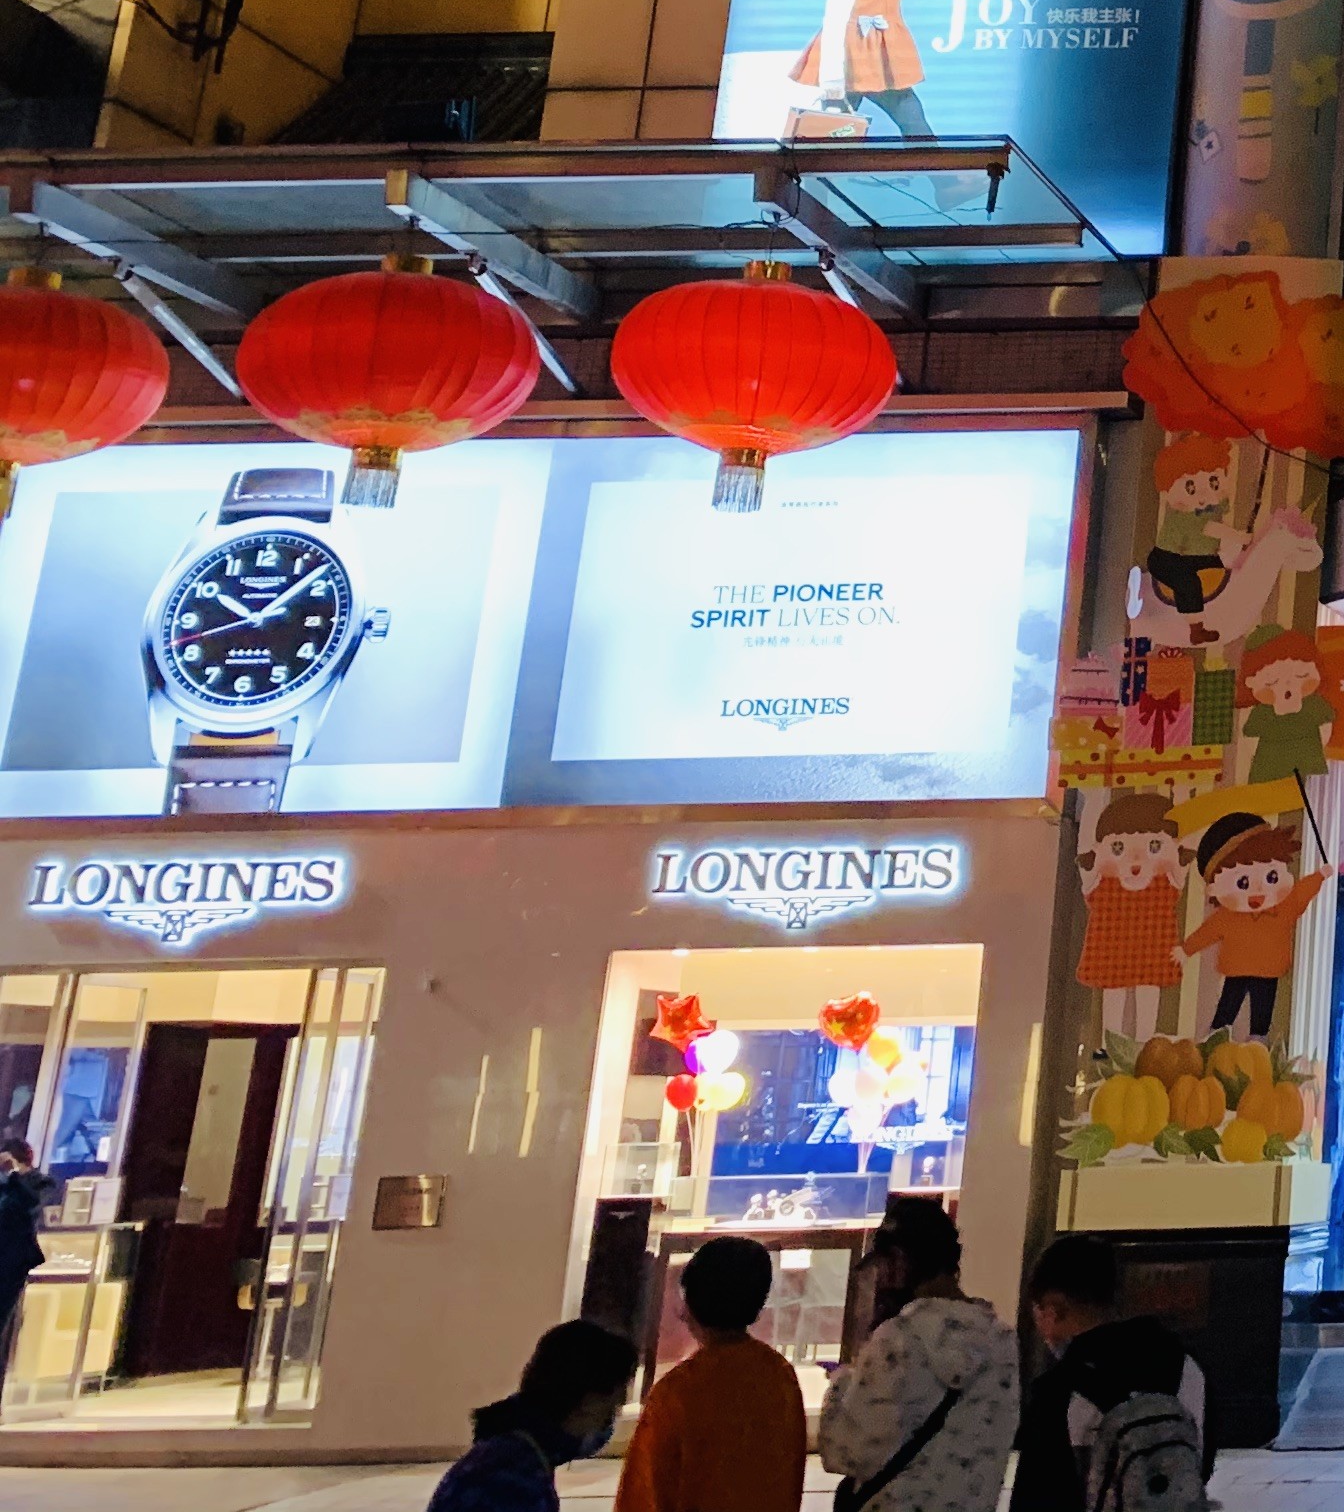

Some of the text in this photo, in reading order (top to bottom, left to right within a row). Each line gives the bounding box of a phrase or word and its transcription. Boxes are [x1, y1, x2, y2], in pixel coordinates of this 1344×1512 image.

[972, 27, 1140, 50] BY MYSELF
[713, 582, 885, 605] THE PIONEER
[690, 608, 772, 629] SPIRIT
[777, 606, 851, 628] LIVES
[720, 696, 850, 719] LONGINES
[652, 848, 956, 894] LONGINES
[28, 860, 339, 906] LONGINES
